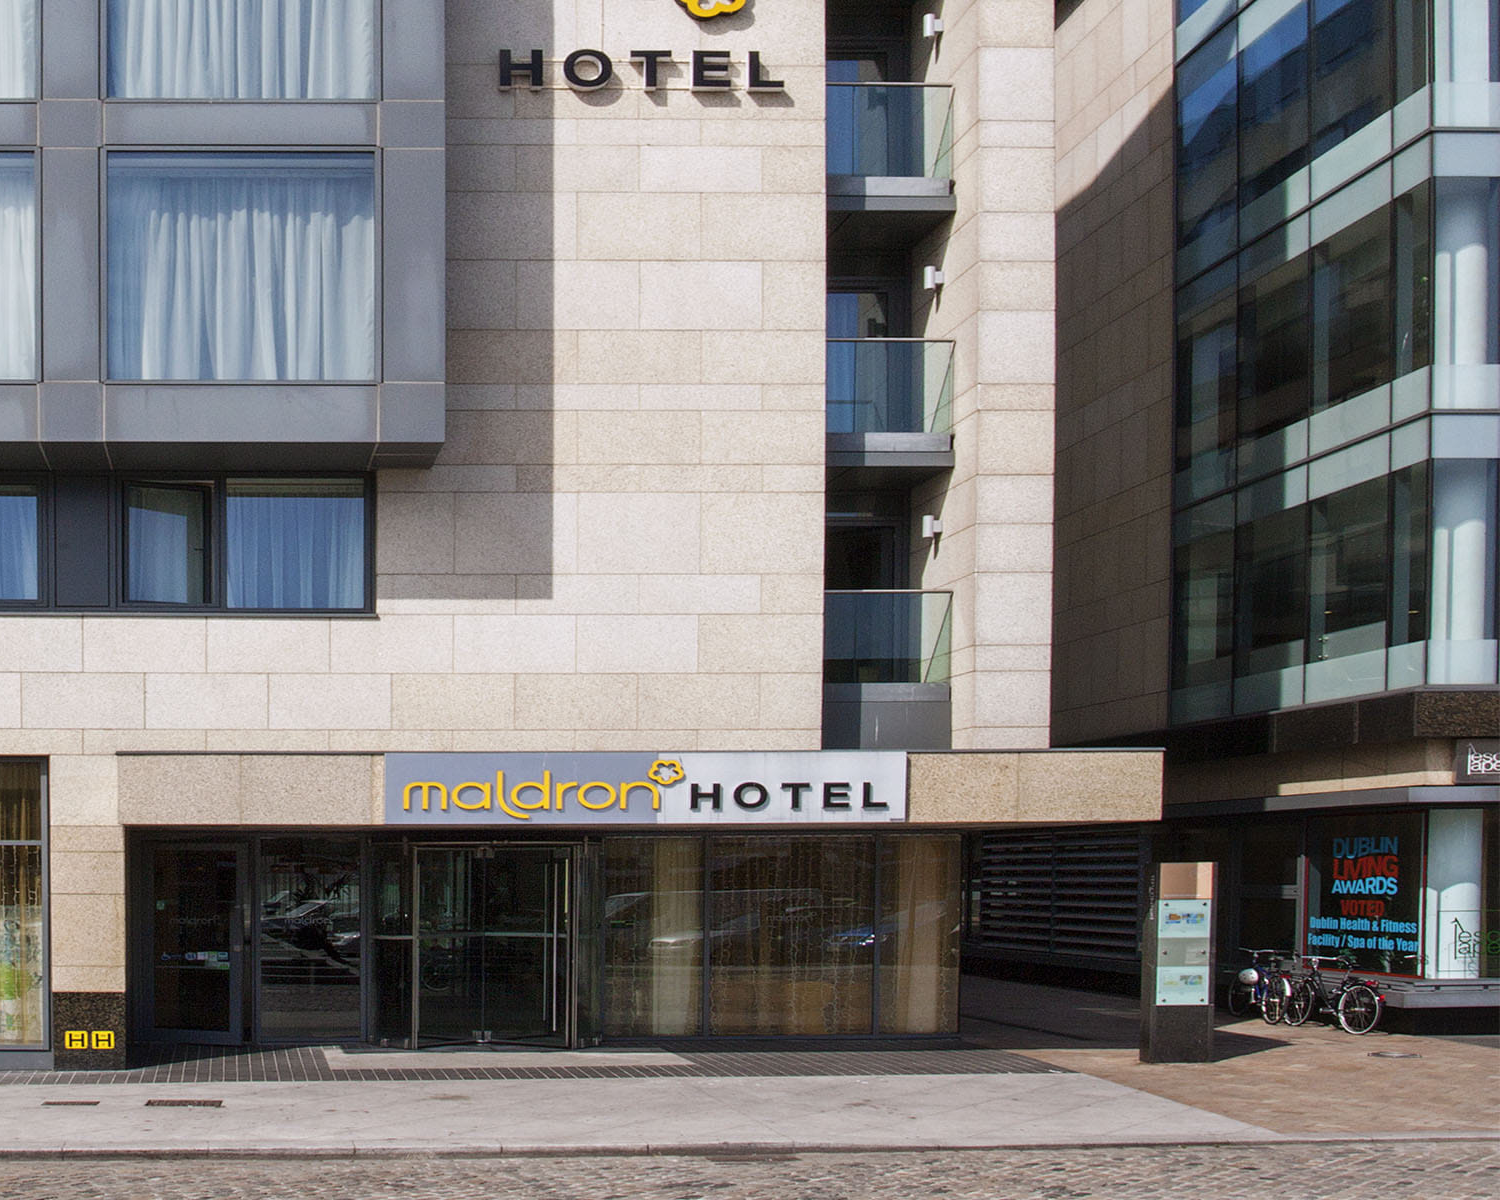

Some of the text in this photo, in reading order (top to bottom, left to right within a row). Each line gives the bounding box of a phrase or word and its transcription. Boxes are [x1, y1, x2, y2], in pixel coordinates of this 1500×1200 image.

[499, 49, 785, 92] HOTEL
[403, 770, 888, 820] maldron HOTEL
[1332, 835, 1399, 859] DUBLIN
[1332, 855, 1399, 881] LIVING
[1331, 876, 1398, 895] AWARDS
[1340, 899, 1385, 917] VOTED
[1310, 916, 1418, 934] Dublin Health & Fitness
[1308, 933, 1340, 948] Facility
[1348, 935, 1365, 949] Spa
[1367, 935, 1377, 949] of
[1378, 936, 1395, 951] the
[1396, 937, 1418, 952] Year
[69, 1033, 84, 1047] H
[96, 1033, 111, 1047] H
